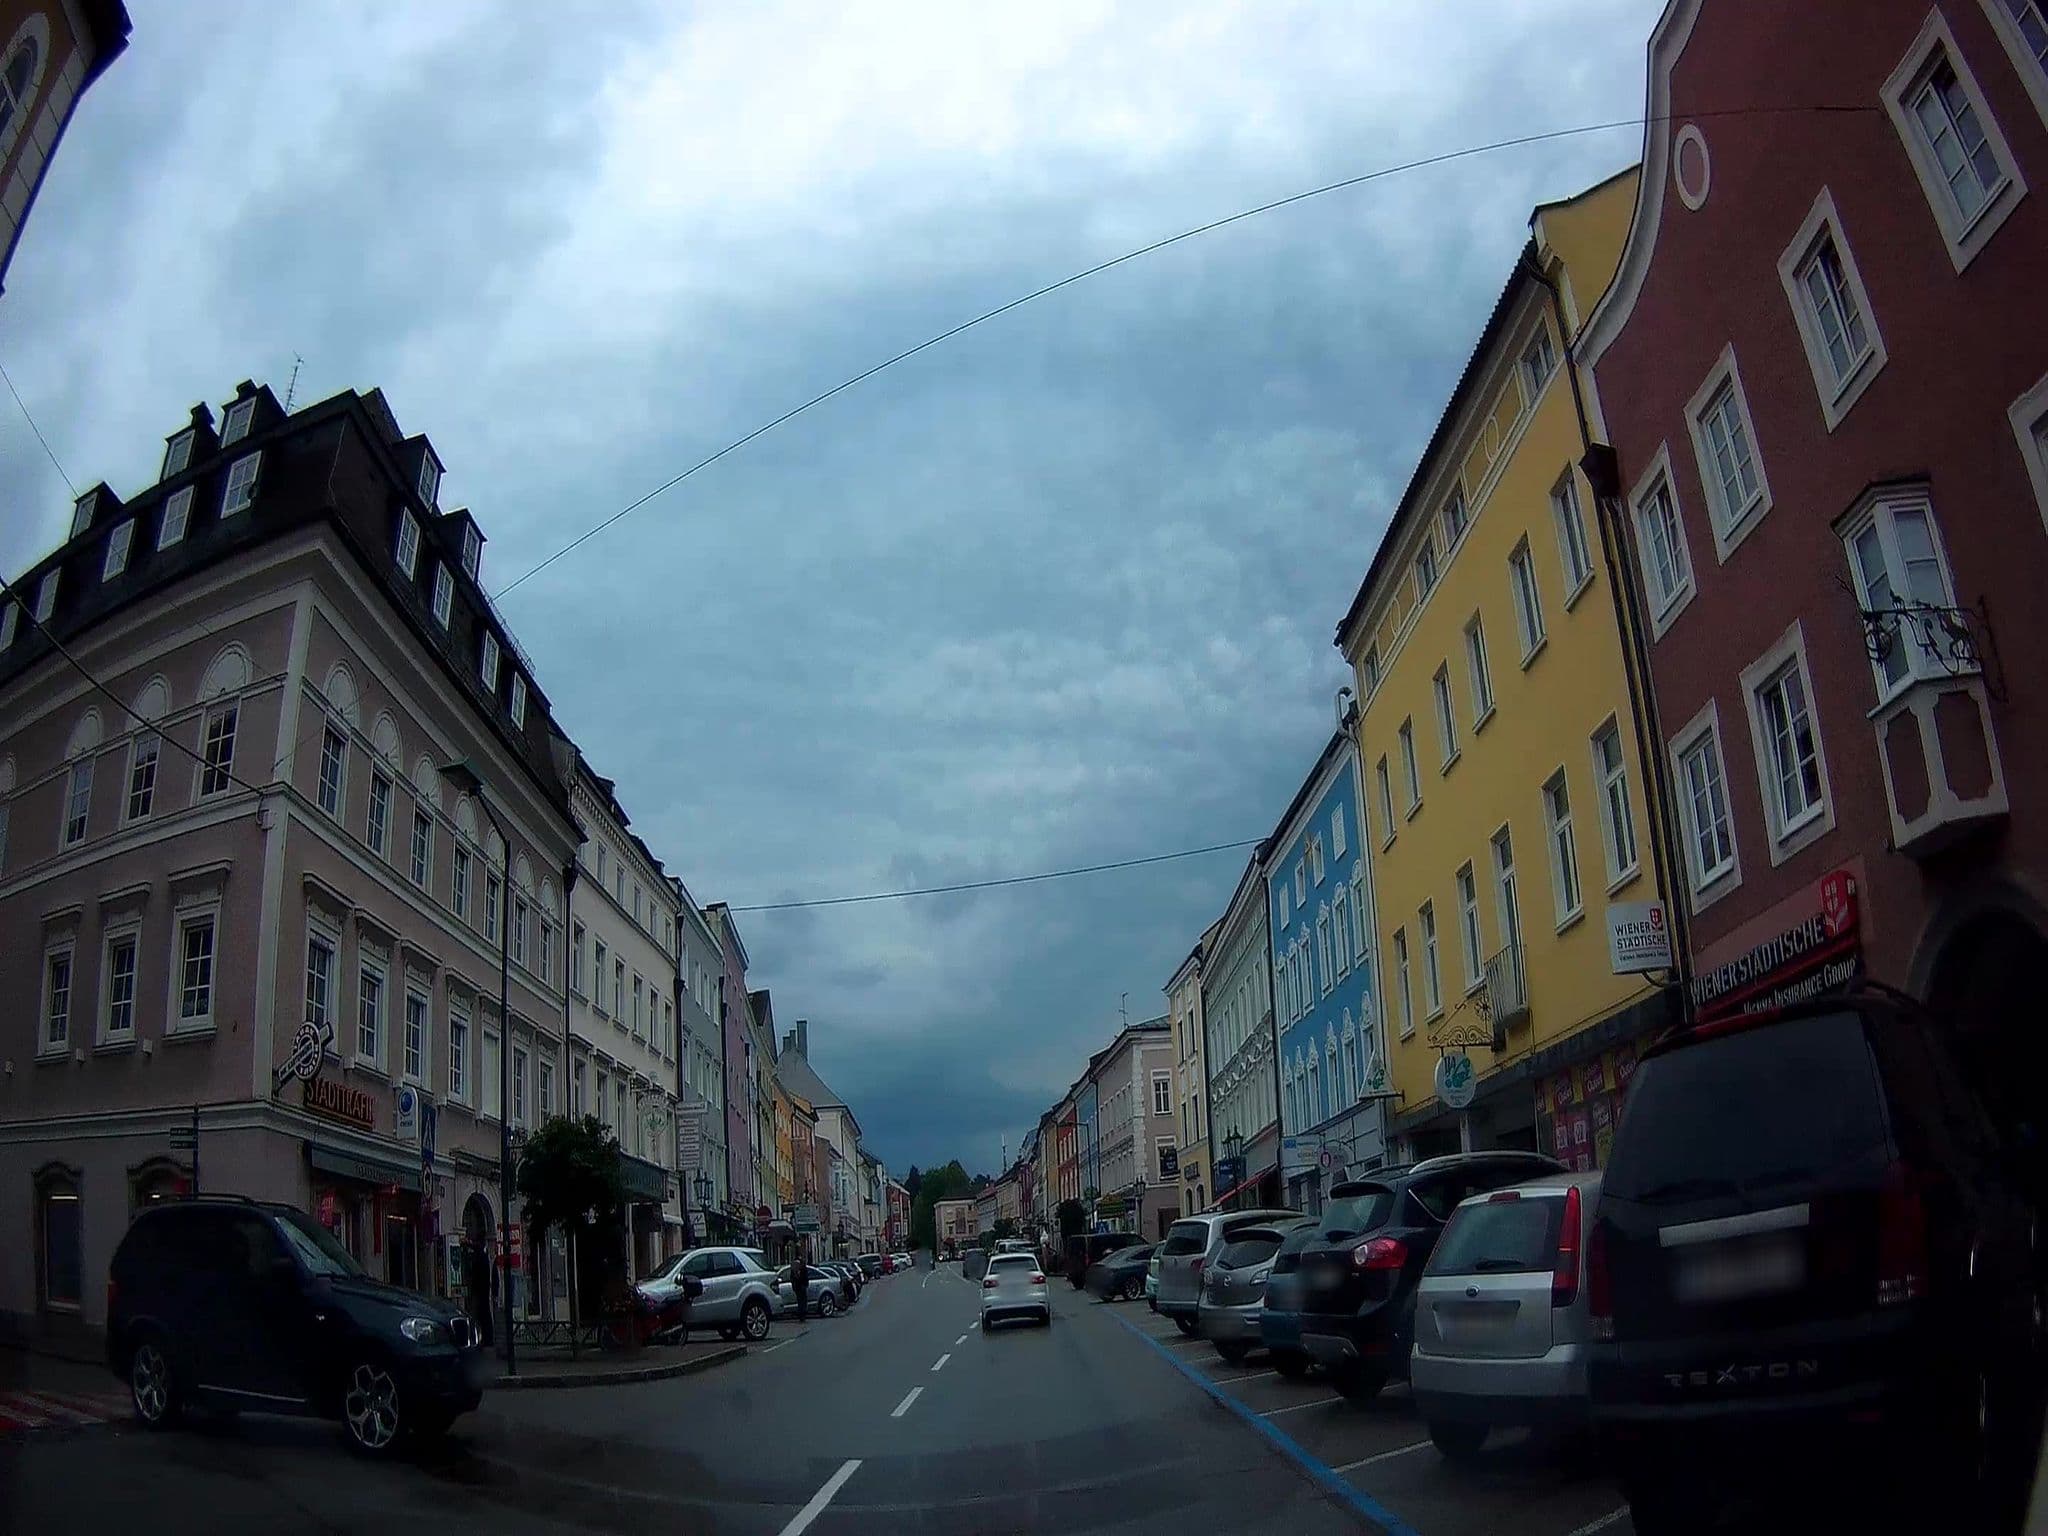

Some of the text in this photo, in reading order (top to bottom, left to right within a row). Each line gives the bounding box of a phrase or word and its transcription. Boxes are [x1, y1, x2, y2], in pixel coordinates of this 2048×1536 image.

[1615, 921, 1651, 936] WIENER
[1617, 934, 1667, 949] STÄDTISCHE
[1689, 963, 1738, 1006] WIENER
[1773, 975, 1822, 1007] INSURANCE
[1823, 958, 1857, 990] GROUP
[1664, 1362, 1820, 1387] REXTON
